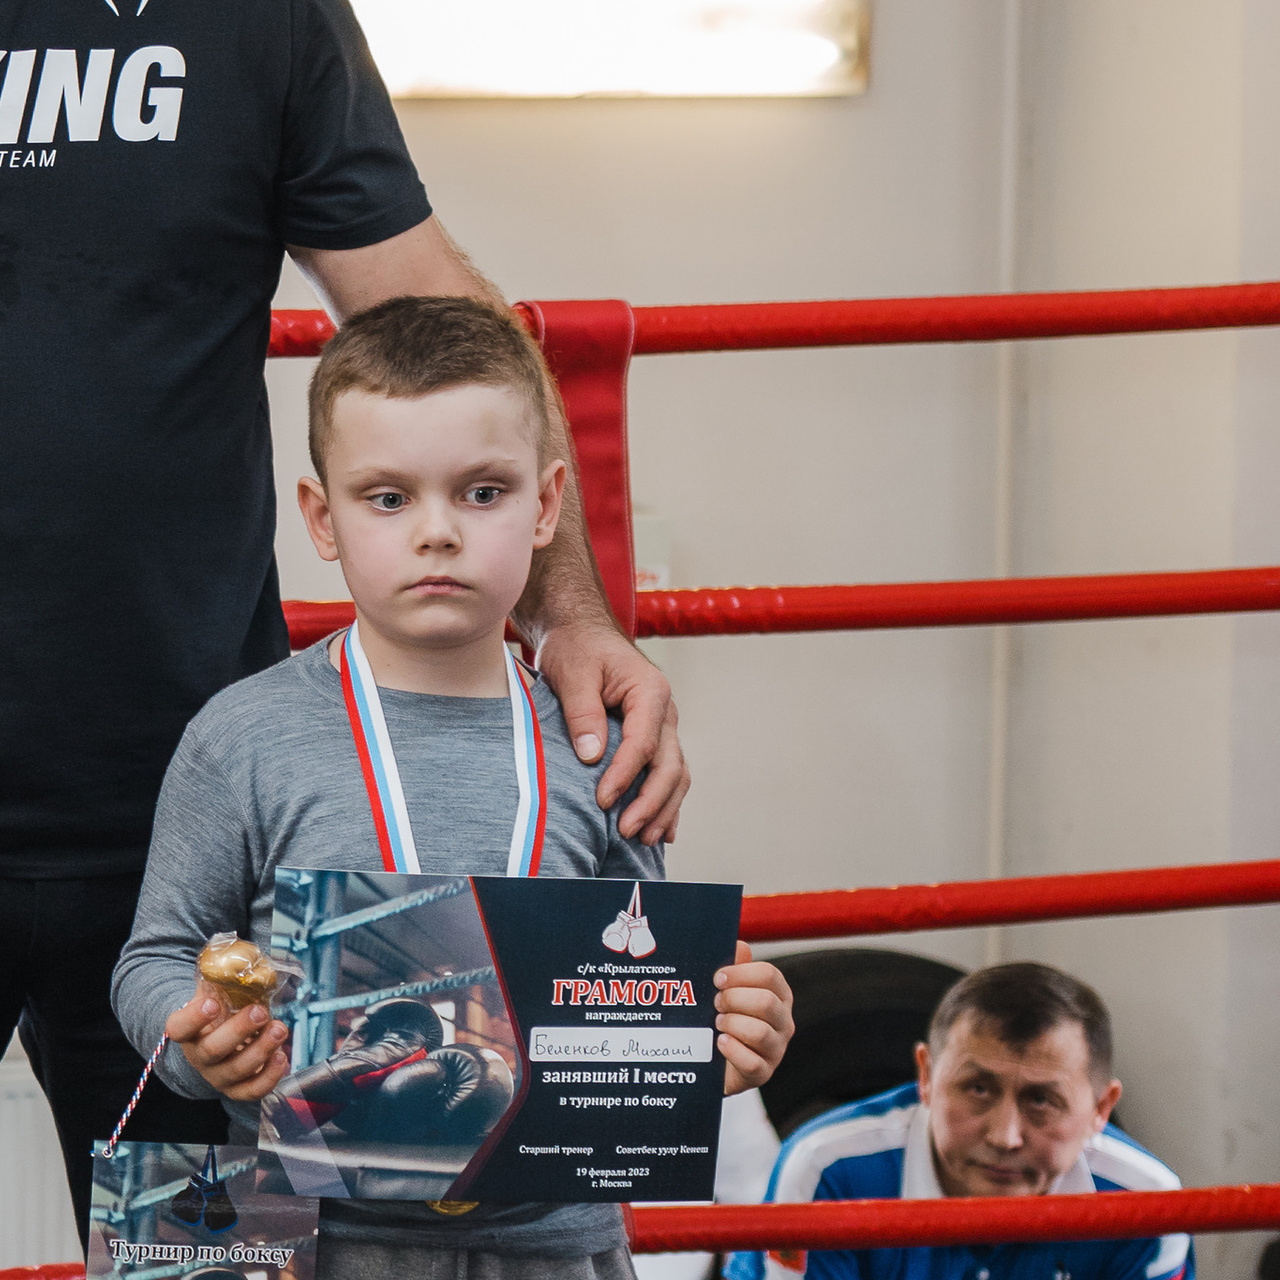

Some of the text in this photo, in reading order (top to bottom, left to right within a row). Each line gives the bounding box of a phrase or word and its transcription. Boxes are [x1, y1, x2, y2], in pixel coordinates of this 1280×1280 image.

[577, 963, 676, 976] с/к «Крылатское»
[551, 979, 697, 1006] ГРАМОТА
[585, 1011, 662, 1022] награждается
[534, 1033, 694, 1057] Беленков Михаил
[542, 1067, 697, 1084] занявший I место
[559, 1094, 678, 1109] в турнире по боксу
[519, 1144, 594, 1156] Старший тренер
[615, 1145, 657, 1155] Советбек
[576, 1167, 650, 1178] 19 февраля 2023
[591, 1179, 633, 1188] г. Москва
[110, 1239, 294, 1268] Турнир по боксу
